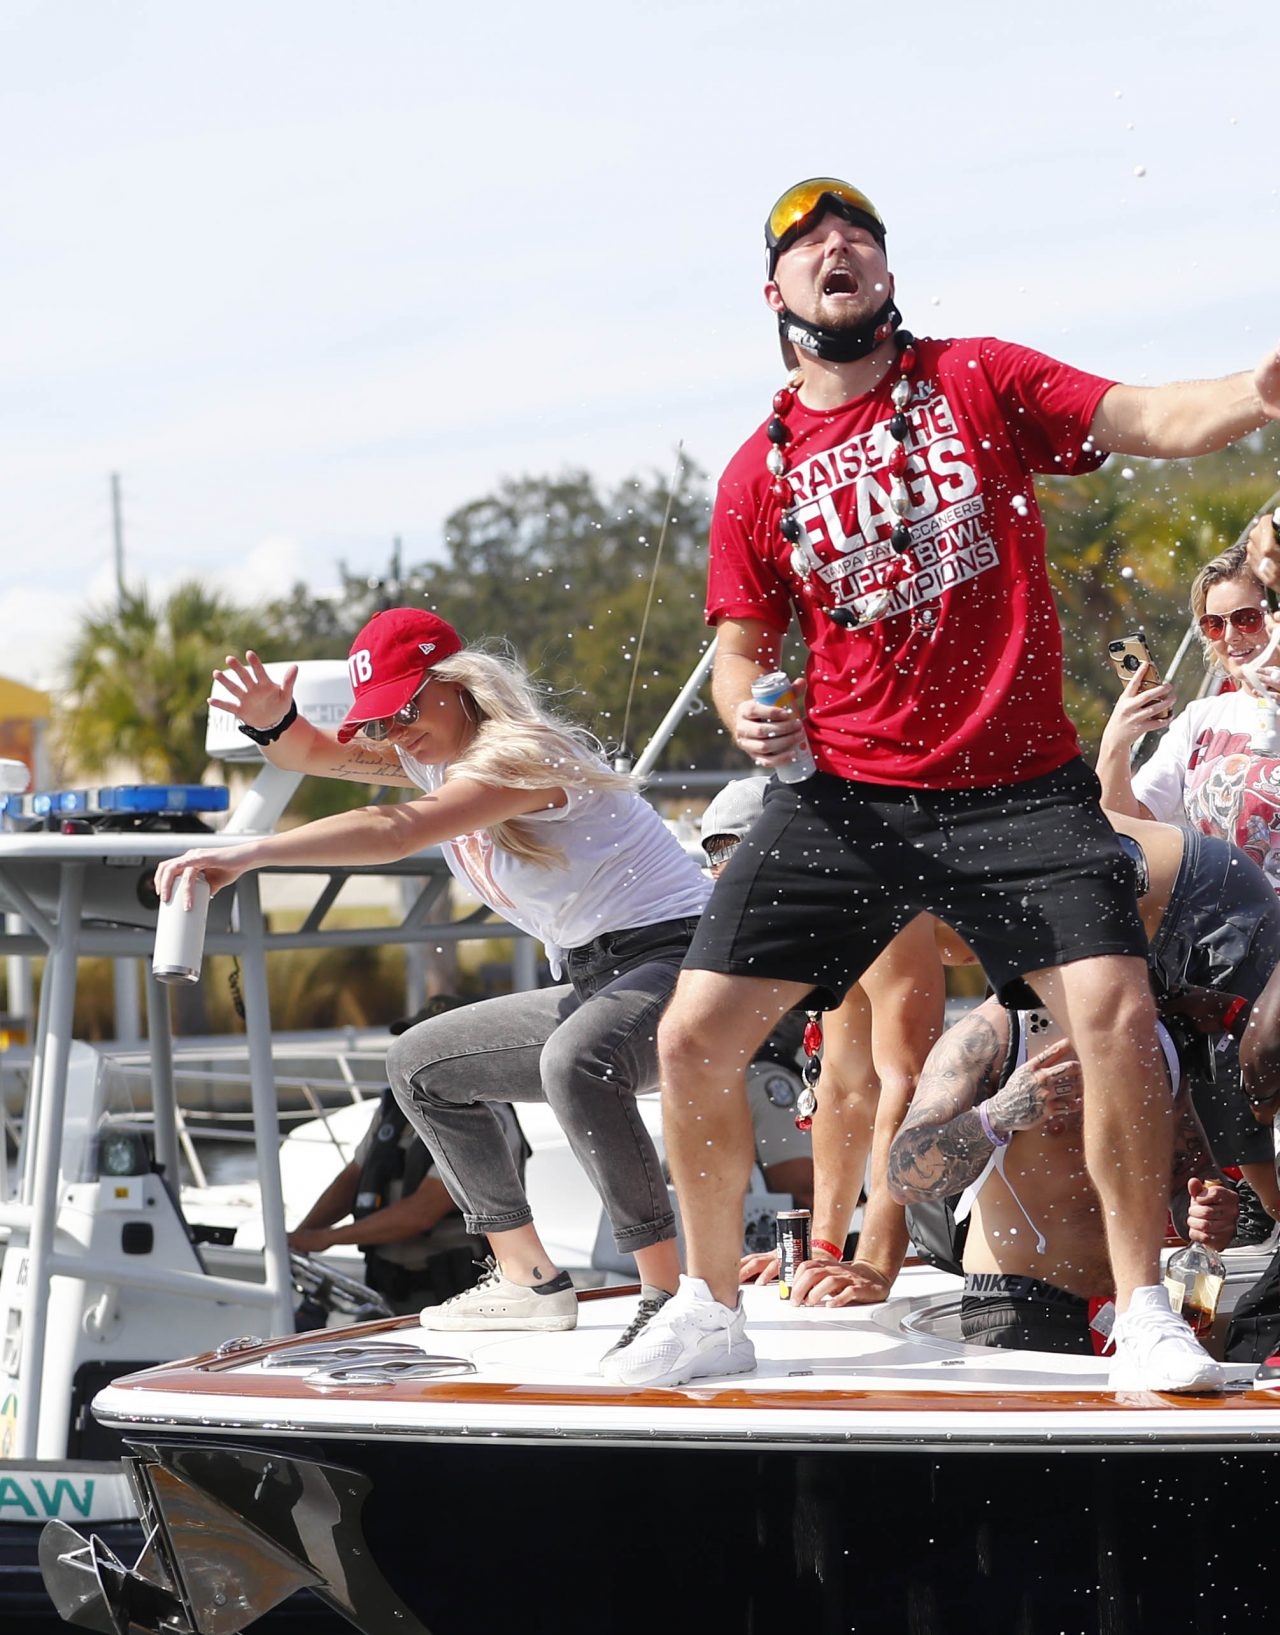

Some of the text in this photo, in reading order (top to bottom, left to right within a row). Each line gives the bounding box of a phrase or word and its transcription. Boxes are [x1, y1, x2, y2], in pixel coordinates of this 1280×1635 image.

[786, 433, 883, 501] RAISE
[790, 437, 977, 570] FLAGS
[821, 499, 982, 579] TAMPA BAY CCANEERS
[914, 517, 989, 567] BOWL
[348, 649, 373, 688] TB
[971, 1273, 1021, 1292] NIKE
